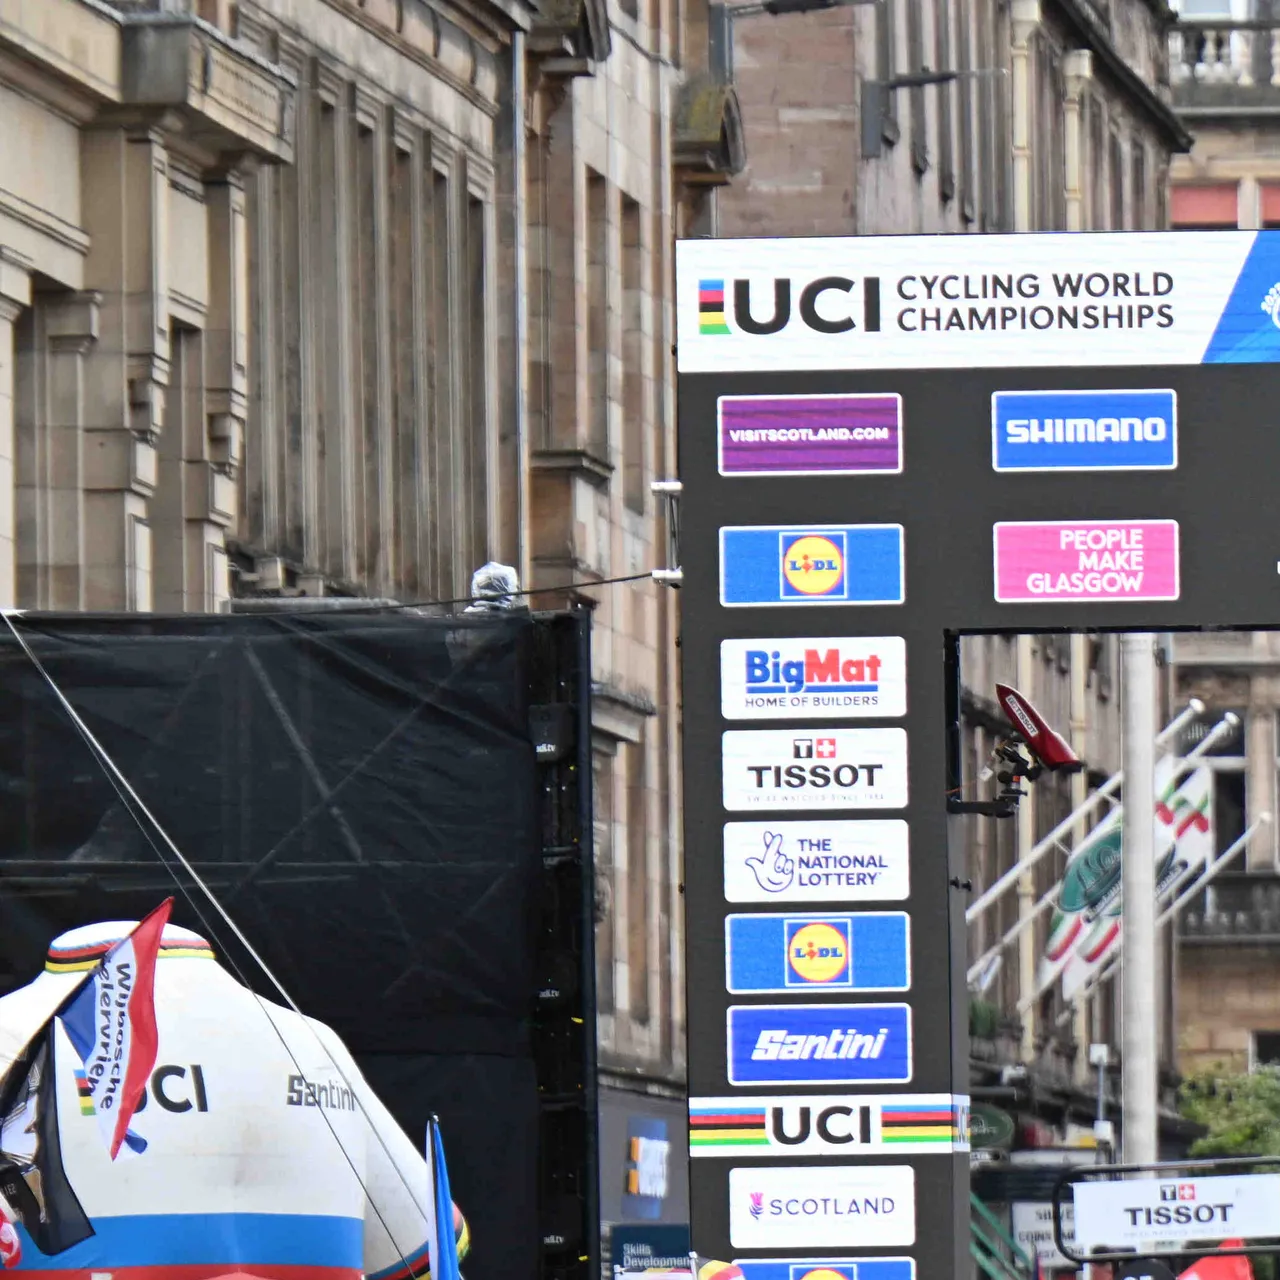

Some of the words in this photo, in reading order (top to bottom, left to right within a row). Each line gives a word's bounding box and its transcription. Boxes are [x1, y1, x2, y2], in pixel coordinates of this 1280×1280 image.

[898, 275, 1039, 299] CYCLING
[1053, 272, 1174, 297] WORLD
[734, 276, 880, 335] UCI
[898, 304, 1174, 332] CHAMPIONSHIPS
[729, 427, 888, 442] VISITSCOTLAND.COM
[1006, 417, 1166, 443] SHIMANO
[1060, 530, 1143, 550] PEOPLE
[1079, 552, 1143, 571] MAKE
[1027, 573, 1143, 593] GLASGOW
[745, 649, 881, 694] BigMat
[746, 697, 786, 708] HOME
[791, 696, 808, 707] OF
[813, 695, 878, 706] BUILDERS
[747, 764, 883, 788] TISSOT
[798, 839, 831, 851] THE
[798, 856, 887, 869] NATIONAL
[799, 872, 877, 886] LOTTERY
[751, 1029, 888, 1060] Santini
[134, 1064, 209, 1113] CI
[772, 1105, 870, 1145] UCI
[770, 1197, 895, 1216] SCOTLAND
[1123, 1203, 1234, 1226] TISSOT
[623, 1243, 651, 1256] Skills
[623, 1255, 692, 1269] Developmen
